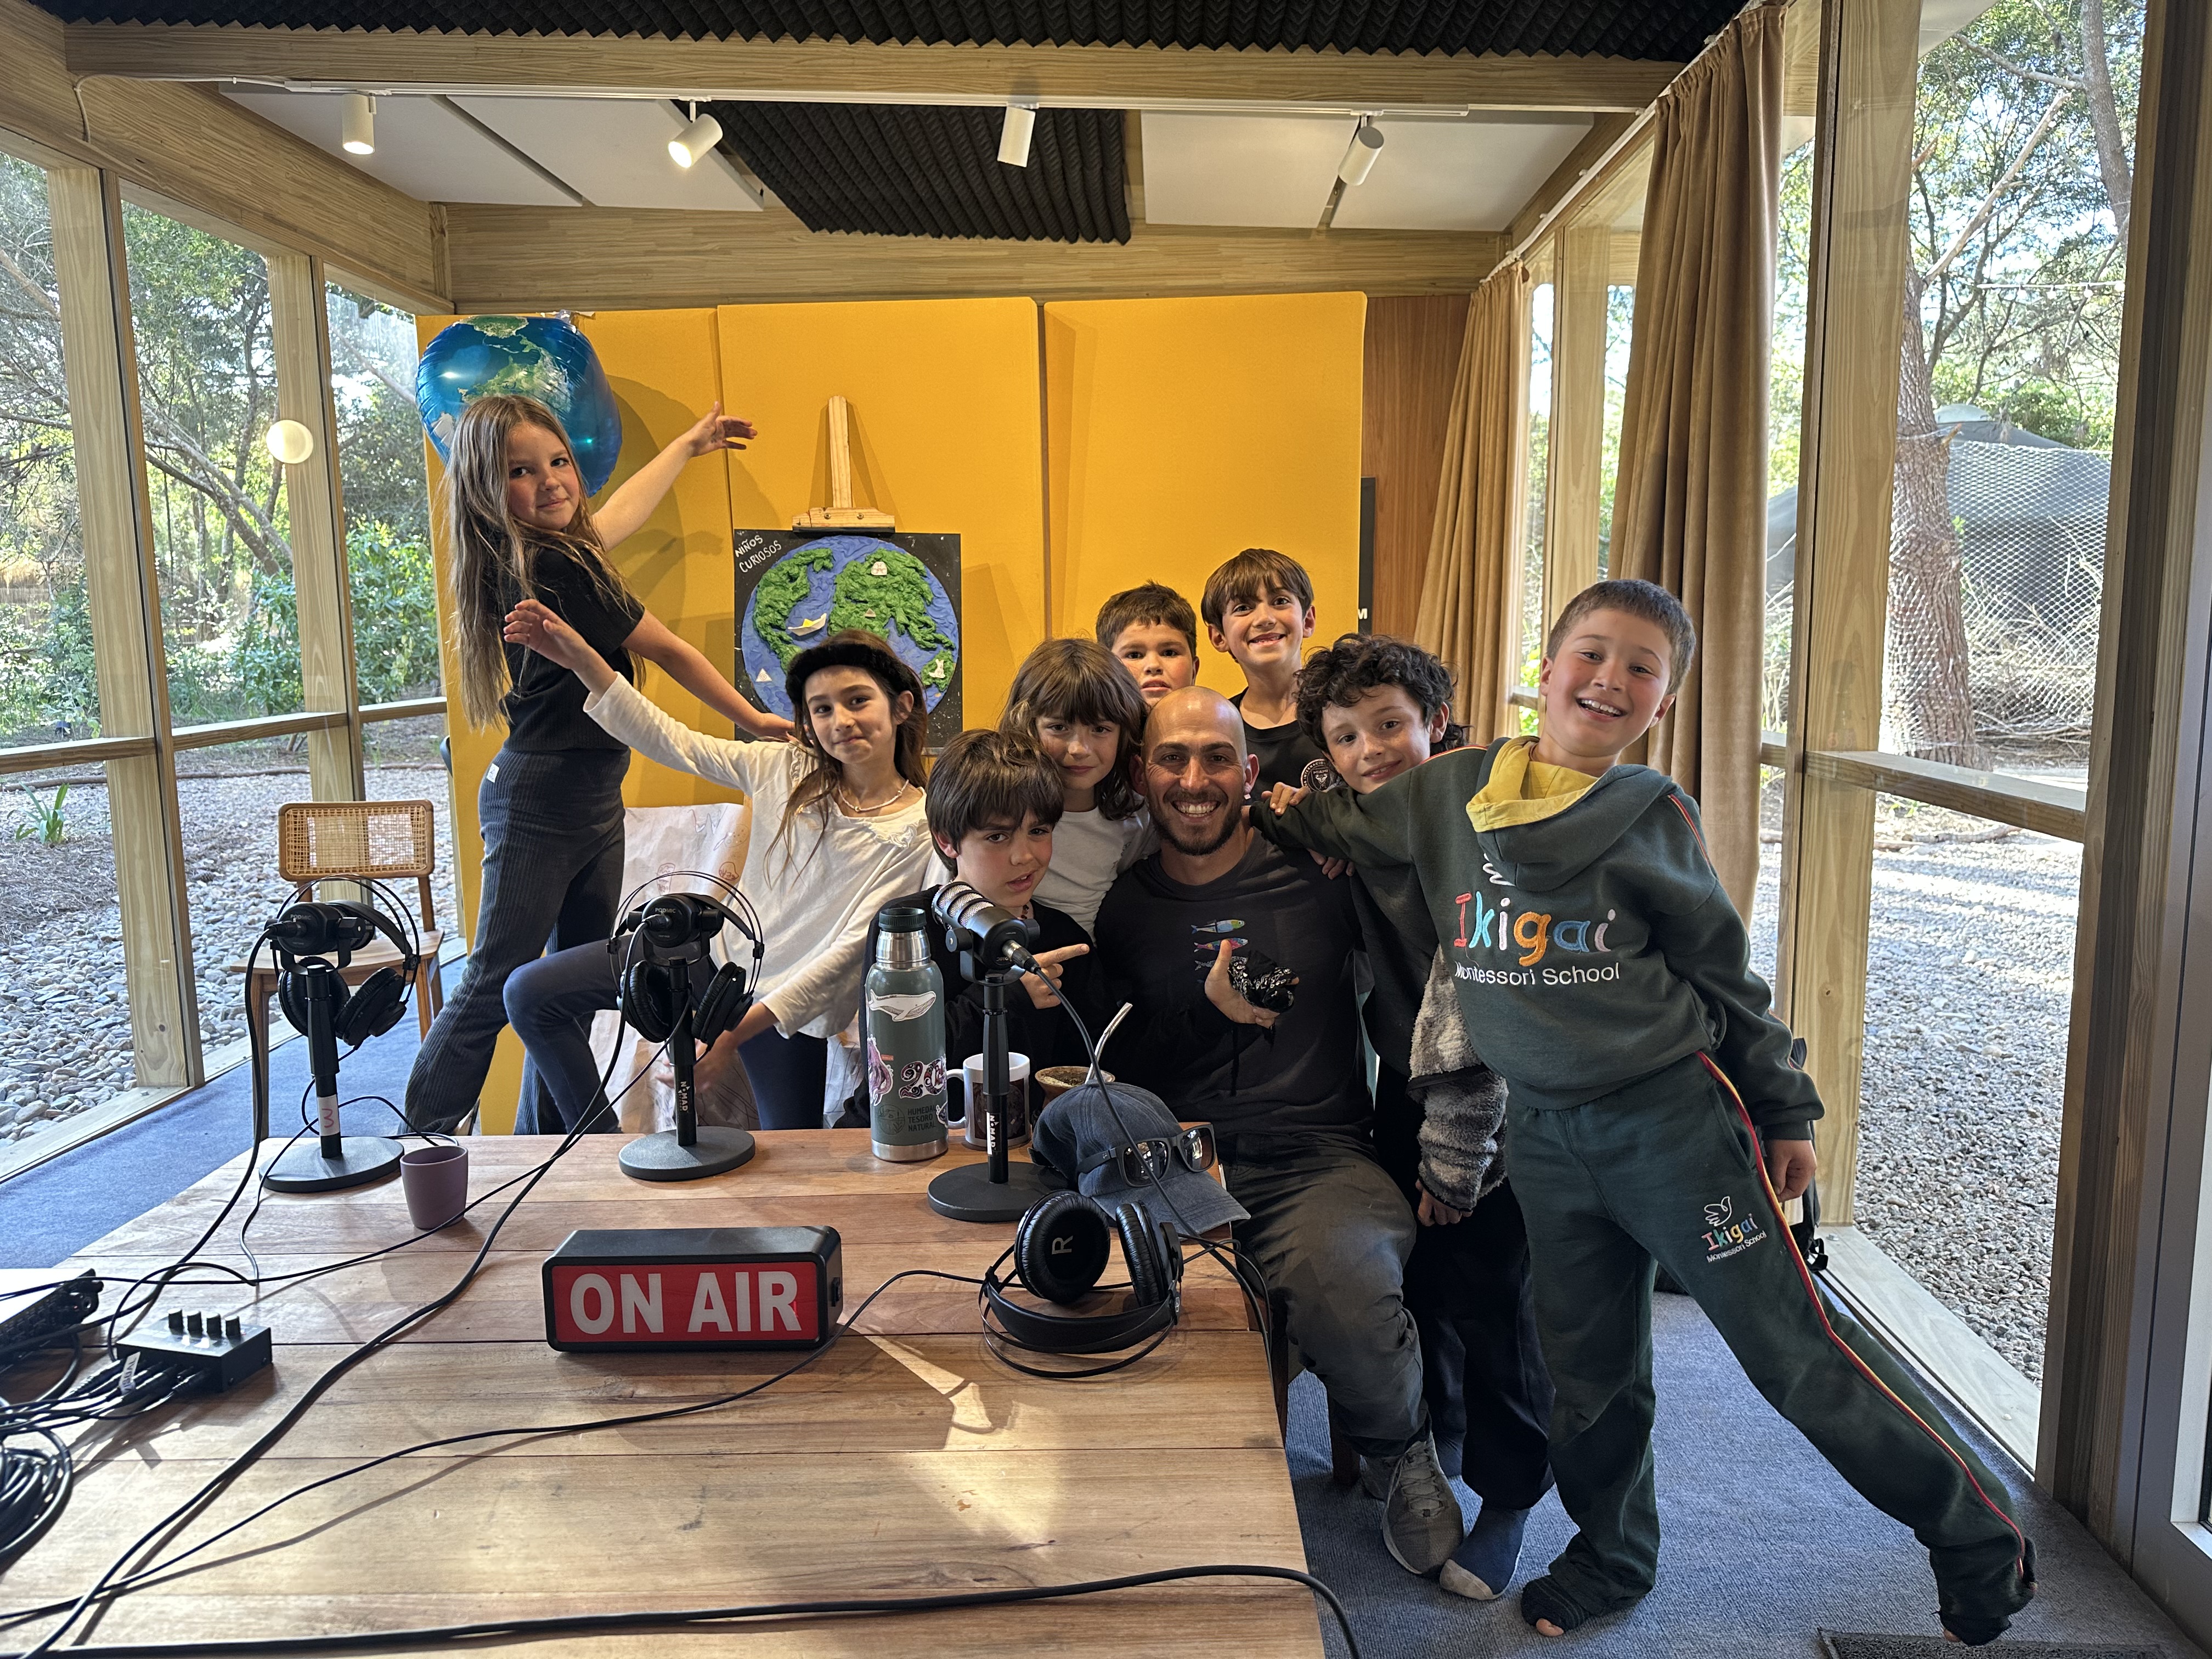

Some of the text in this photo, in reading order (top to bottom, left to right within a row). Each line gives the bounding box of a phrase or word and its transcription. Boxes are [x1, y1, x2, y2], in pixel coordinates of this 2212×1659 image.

[735, 535, 763, 557] NIÑOS
[739, 540, 782, 573] CURIOSOS
[1454, 891, 1616, 967] Ikigai
[1455, 960, 1620, 986] Montessori School
[321, 1108, 335, 1128] 3
[907, 1105, 936, 1115] HUMEDAL
[908, 1113, 933, 1124] TESORO
[908, 1121, 936, 1132] NATURAL
[1701, 1213, 1758, 1251] Ikigai
[1052, 1235, 1074, 1255] R
[1706, 1230, 1767, 1263] Montessori School
[570, 1271, 802, 1334] ON AIR
